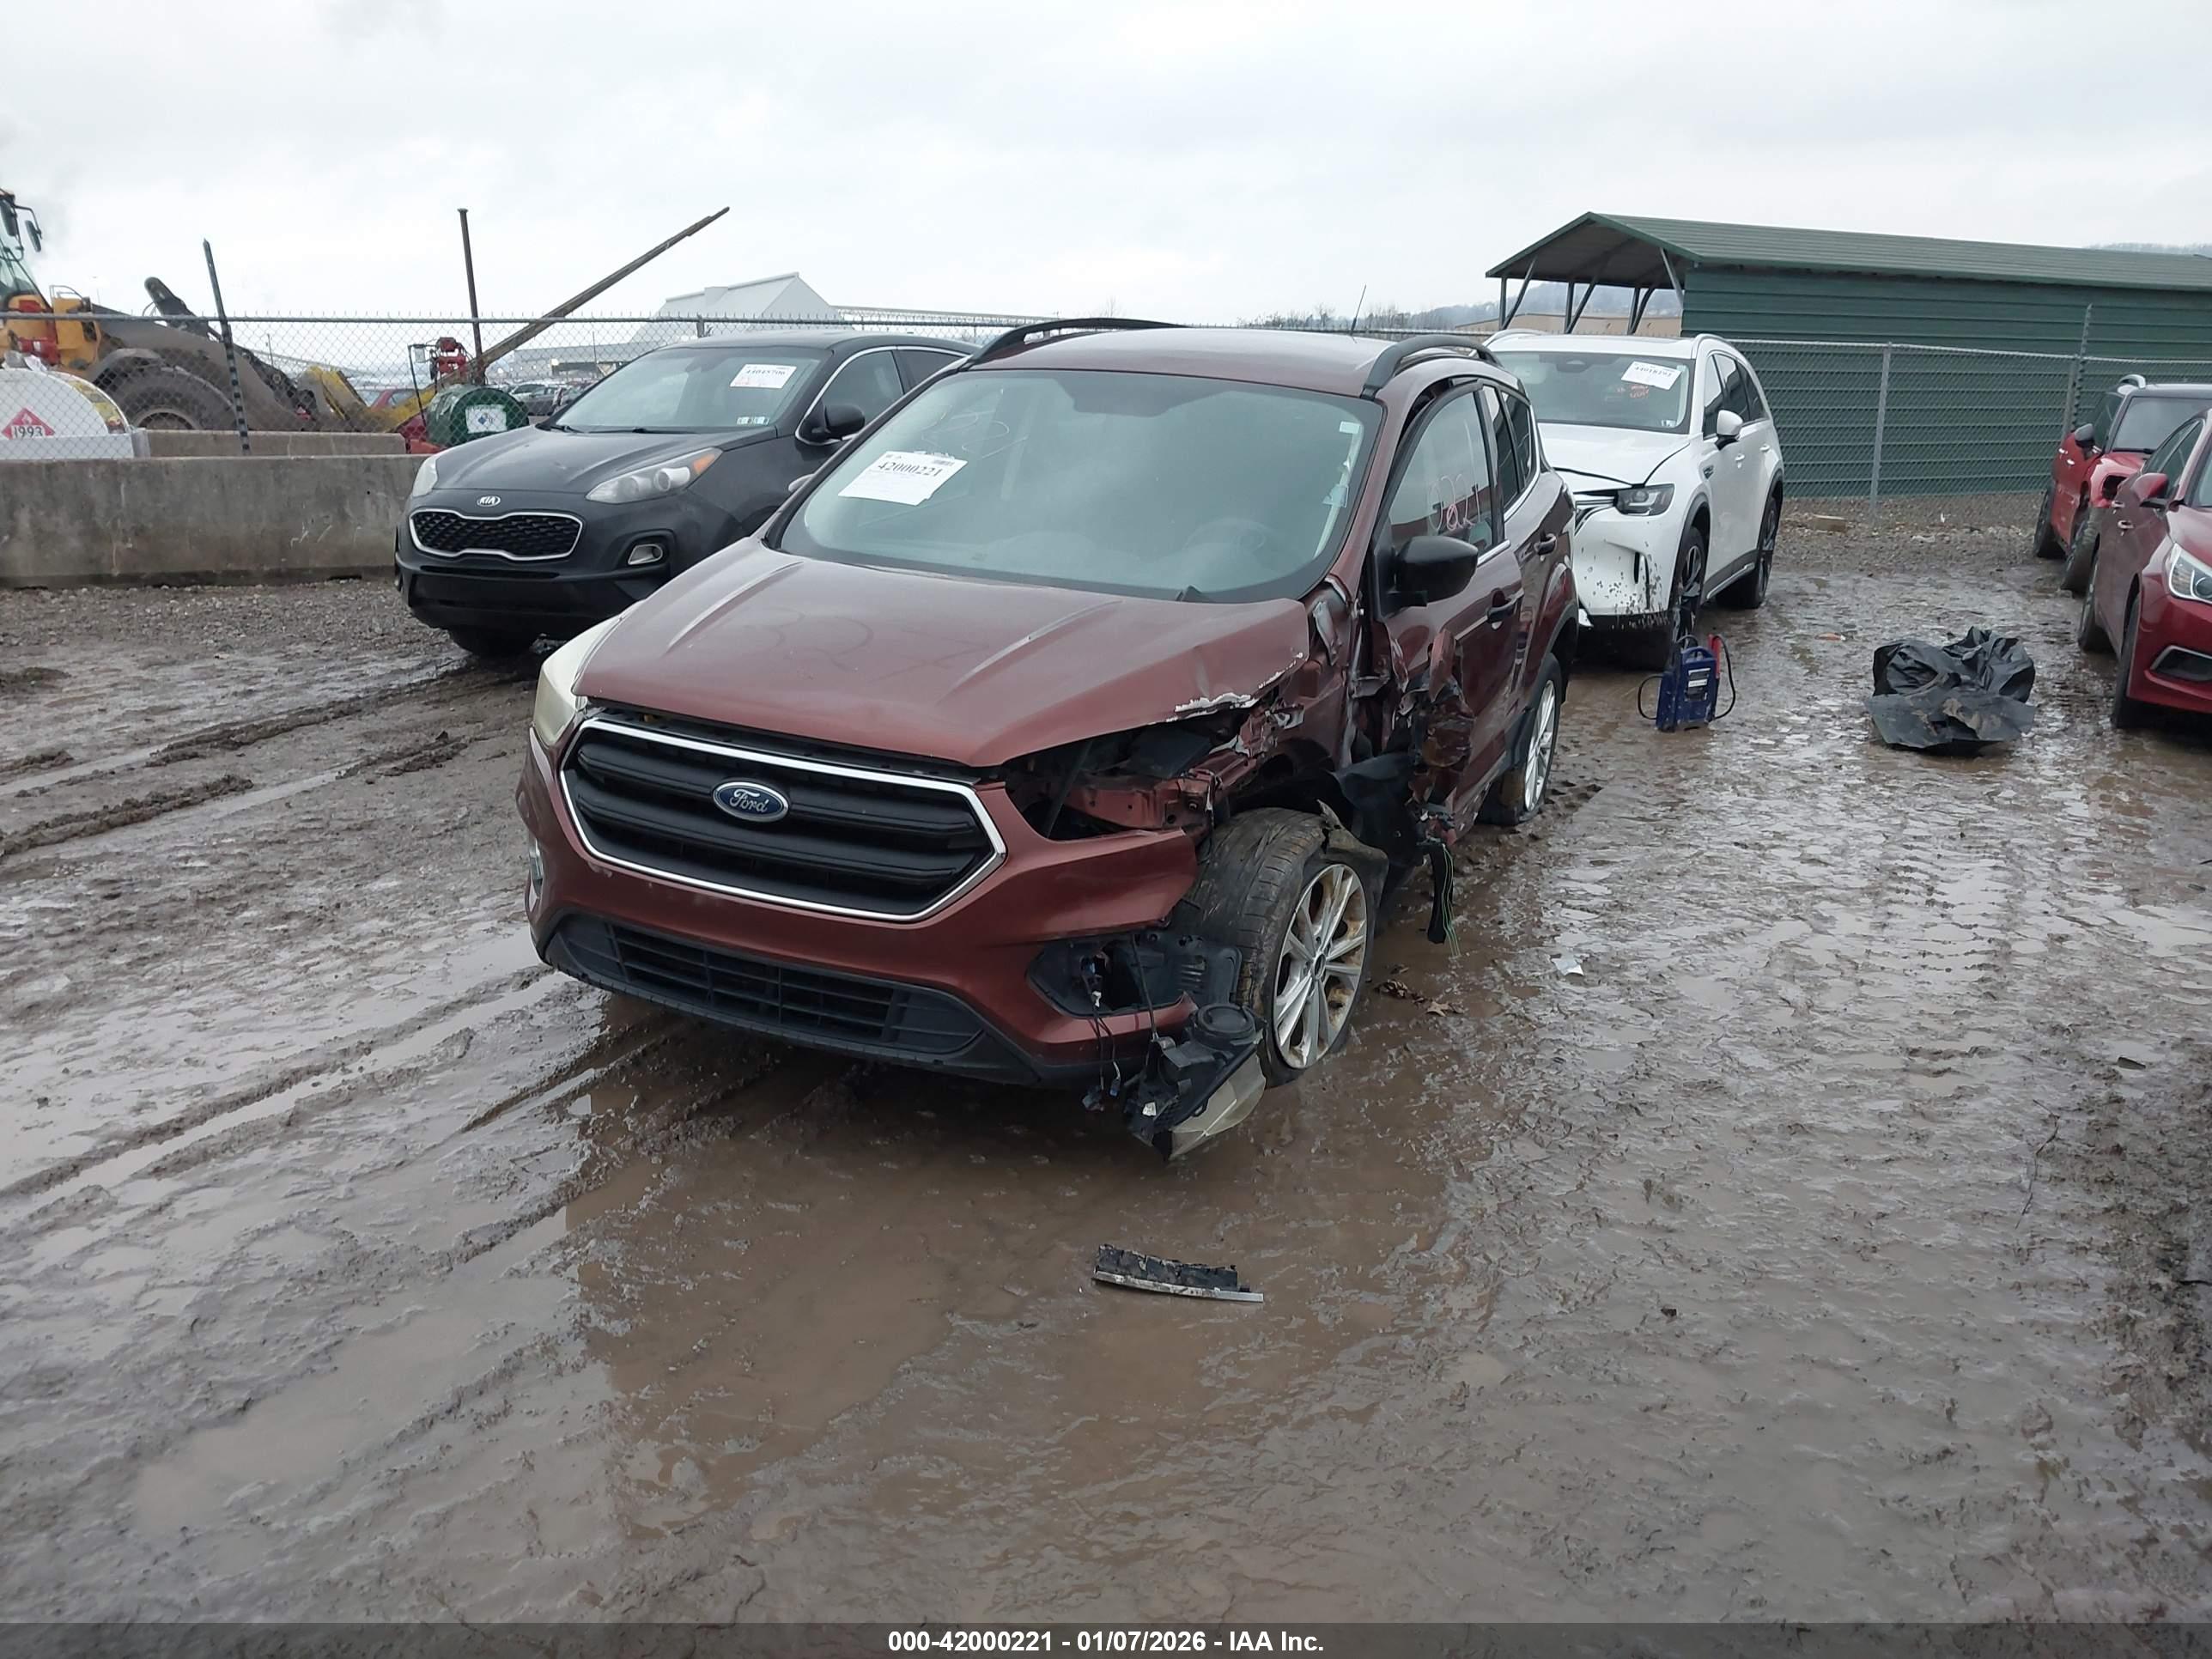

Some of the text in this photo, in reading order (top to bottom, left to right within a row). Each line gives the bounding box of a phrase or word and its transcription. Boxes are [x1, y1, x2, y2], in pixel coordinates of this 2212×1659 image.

[13, 425, 43, 439] 1993
[878, 461, 943, 477] 42000221
[479, 495, 496, 505] KIA
[730, 789, 769, 812] Ford
